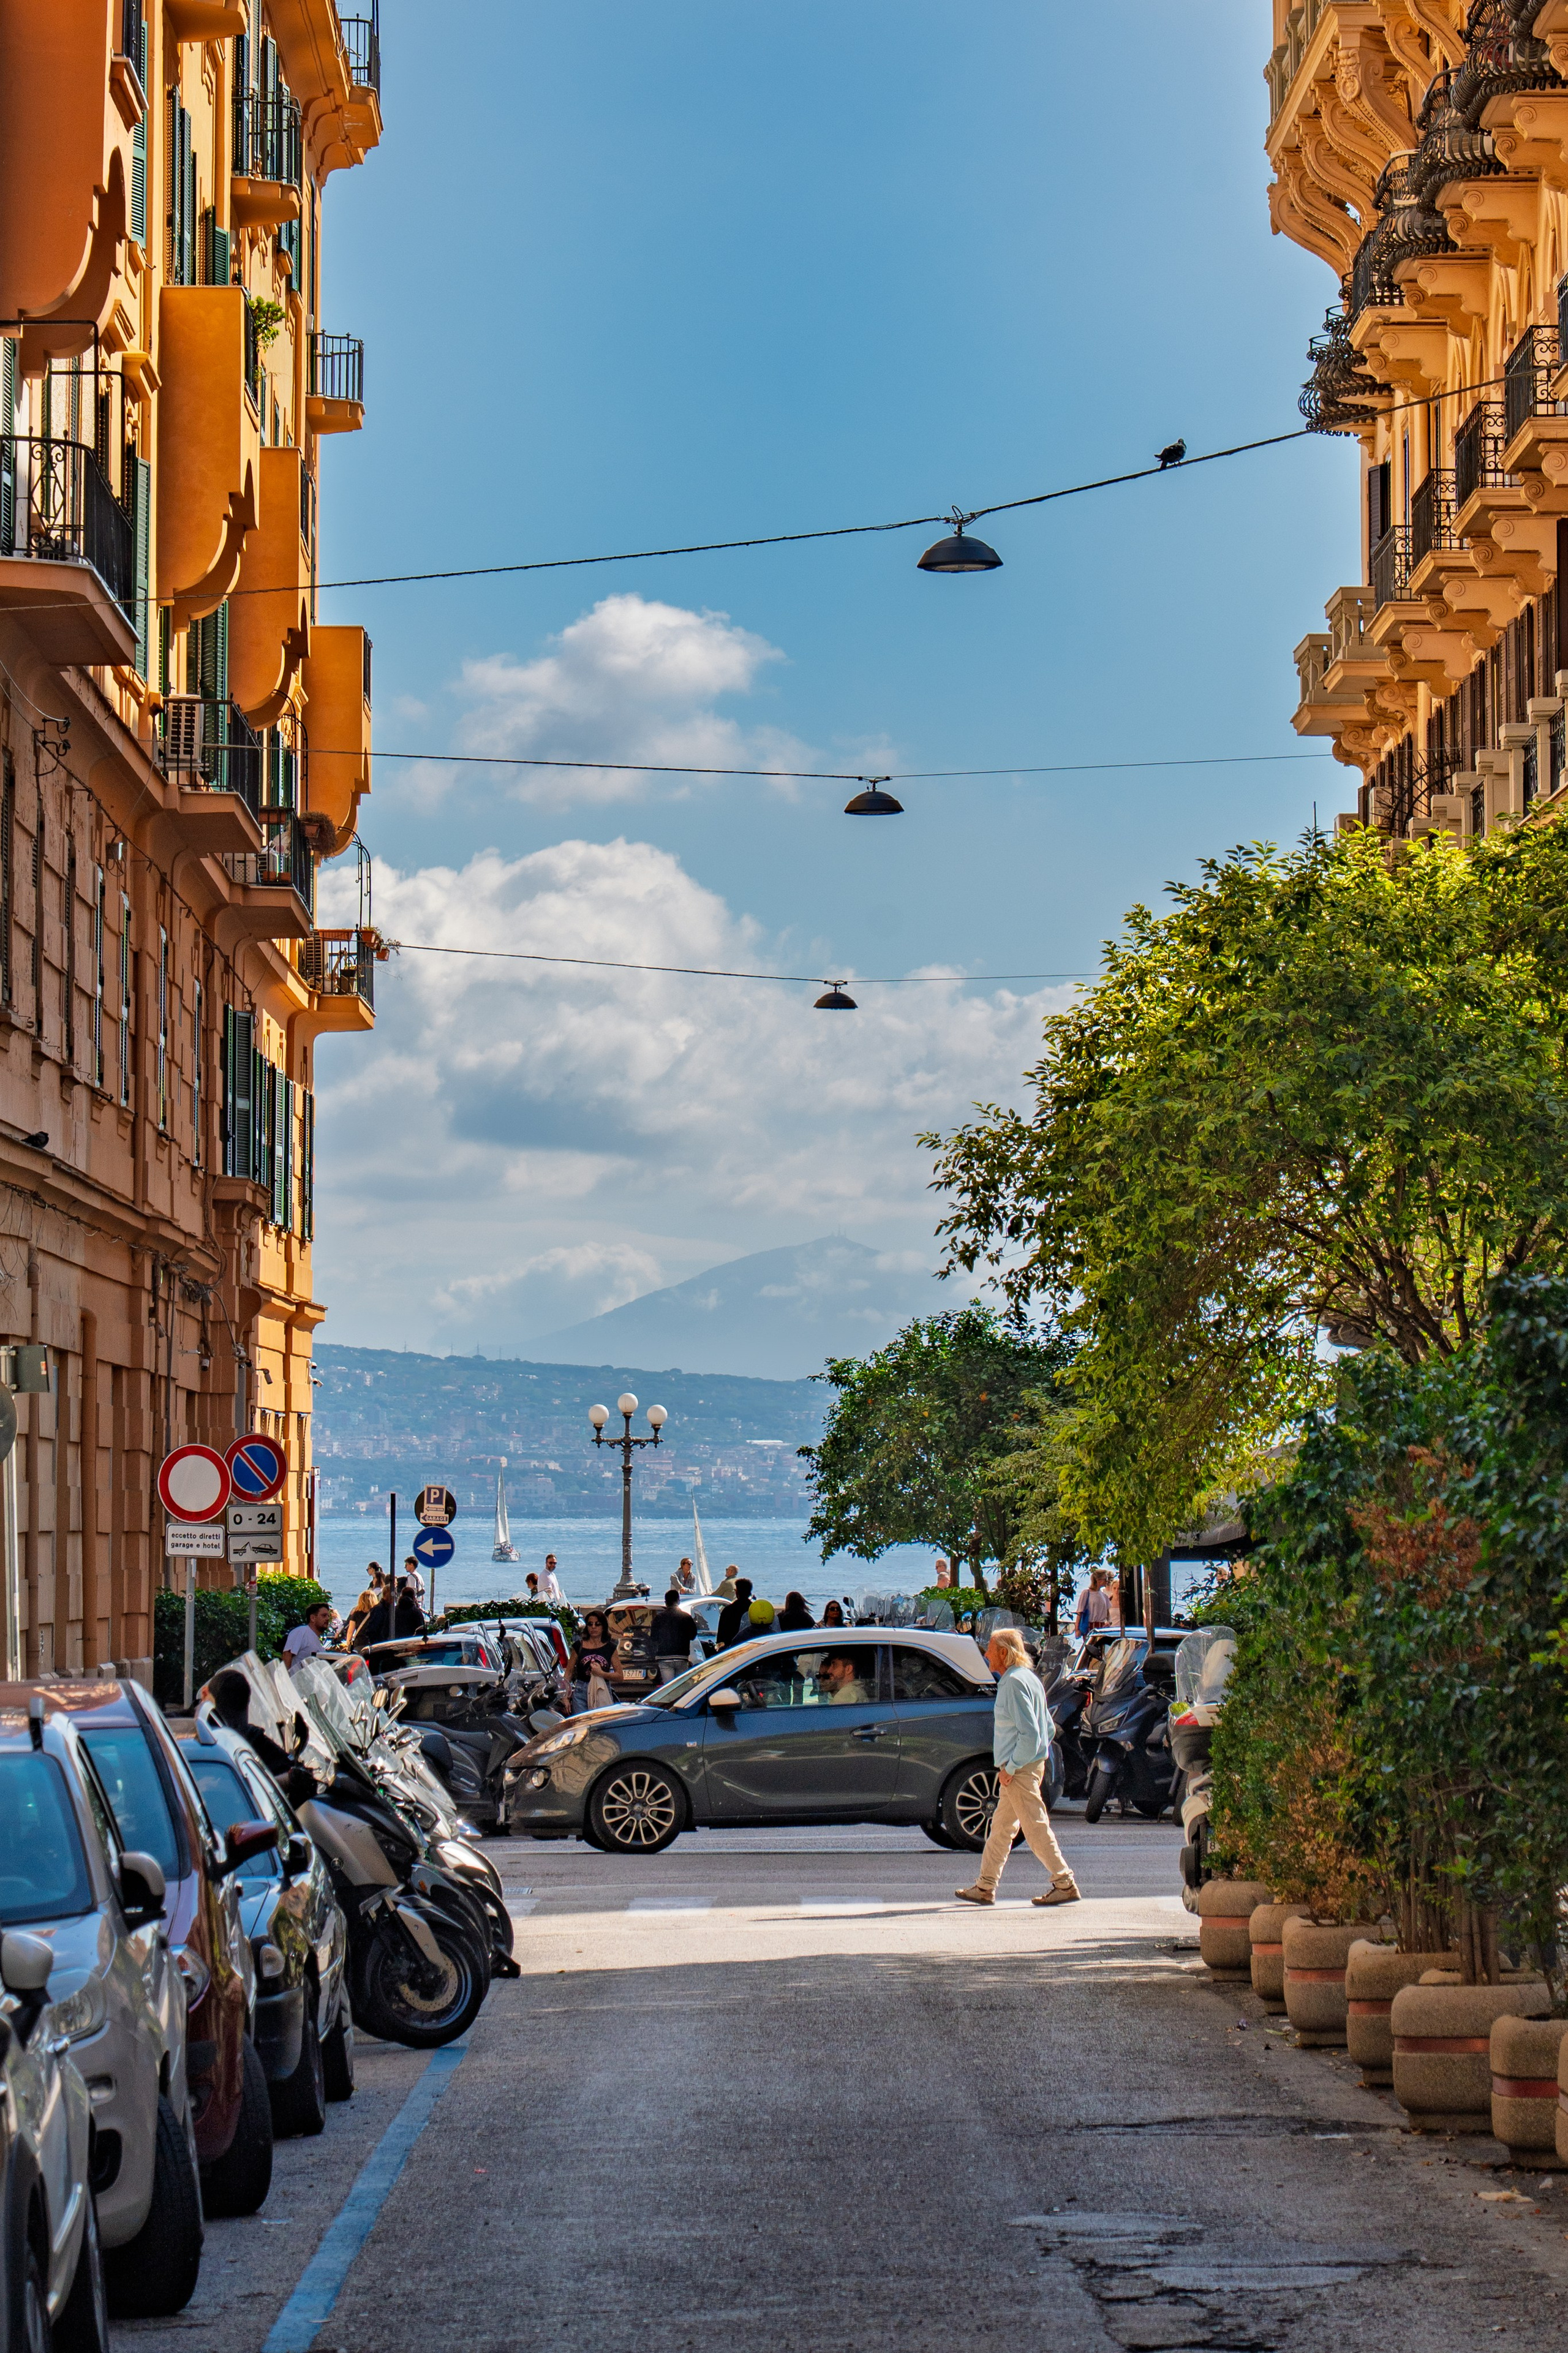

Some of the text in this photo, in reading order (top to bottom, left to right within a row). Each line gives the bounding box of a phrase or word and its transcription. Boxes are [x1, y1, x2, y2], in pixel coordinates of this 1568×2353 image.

[431, 1489, 440, 1503] P
[233, 1514, 243, 1525] 0
[257, 1513, 276, 1524] 24
